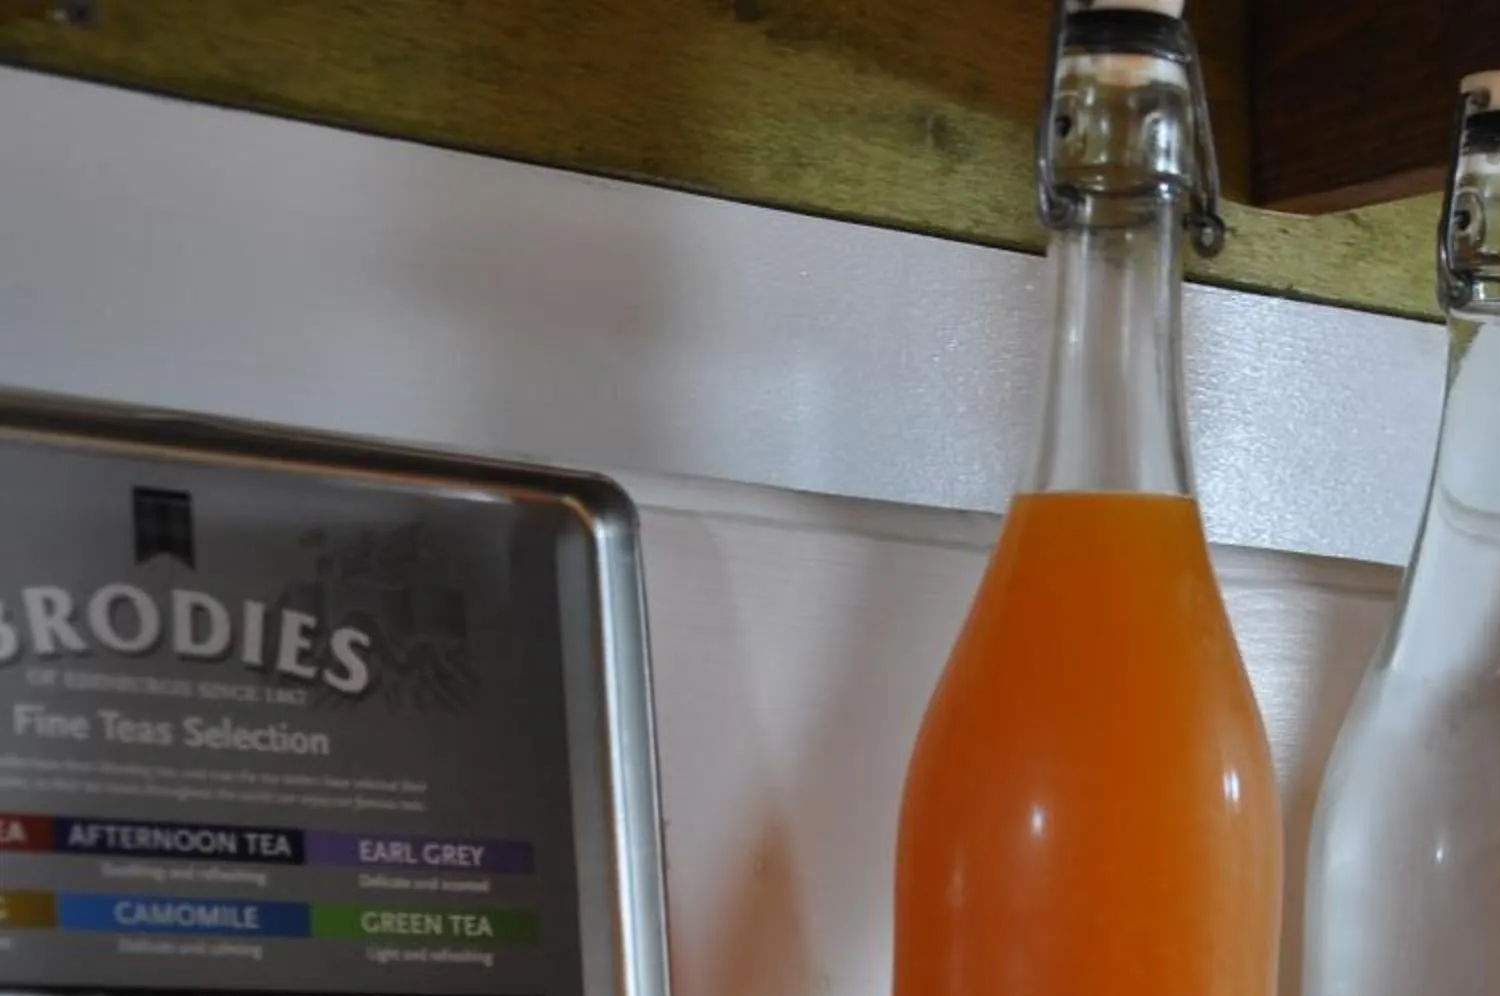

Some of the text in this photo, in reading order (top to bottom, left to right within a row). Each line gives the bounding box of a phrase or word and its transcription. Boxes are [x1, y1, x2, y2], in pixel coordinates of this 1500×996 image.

[12, 702, 331, 756] Fine Teas Selection
[68, 822, 293, 858] AFTERNOON TEA
[358, 839, 487, 868] EARL GREY
[113, 900, 261, 930] CAMOMILE
[360, 910, 495, 938] GREEN TEA
